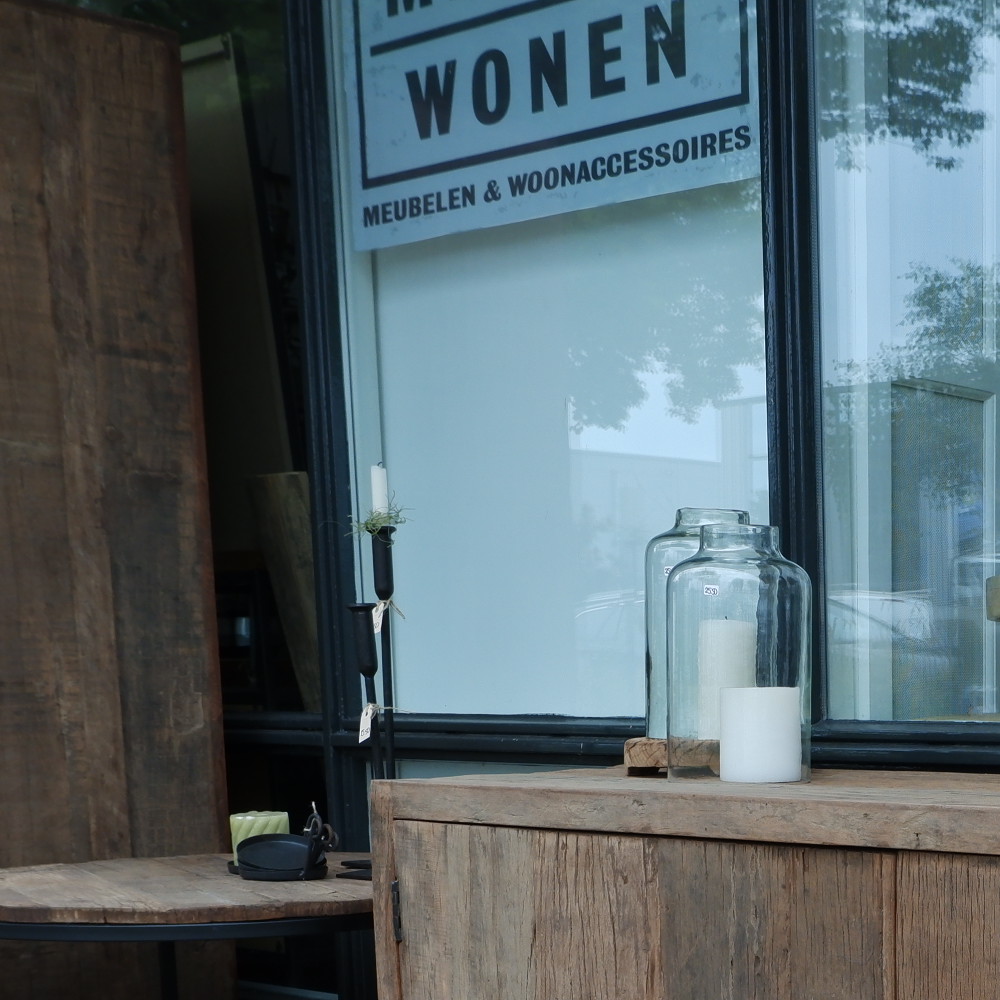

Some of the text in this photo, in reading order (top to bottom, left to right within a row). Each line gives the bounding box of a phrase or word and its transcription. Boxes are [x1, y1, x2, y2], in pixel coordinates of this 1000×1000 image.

[405, 0, 687, 140] WONEN
[362, 125, 751, 228] MEUBELEN & WOONACCESSOIRES
